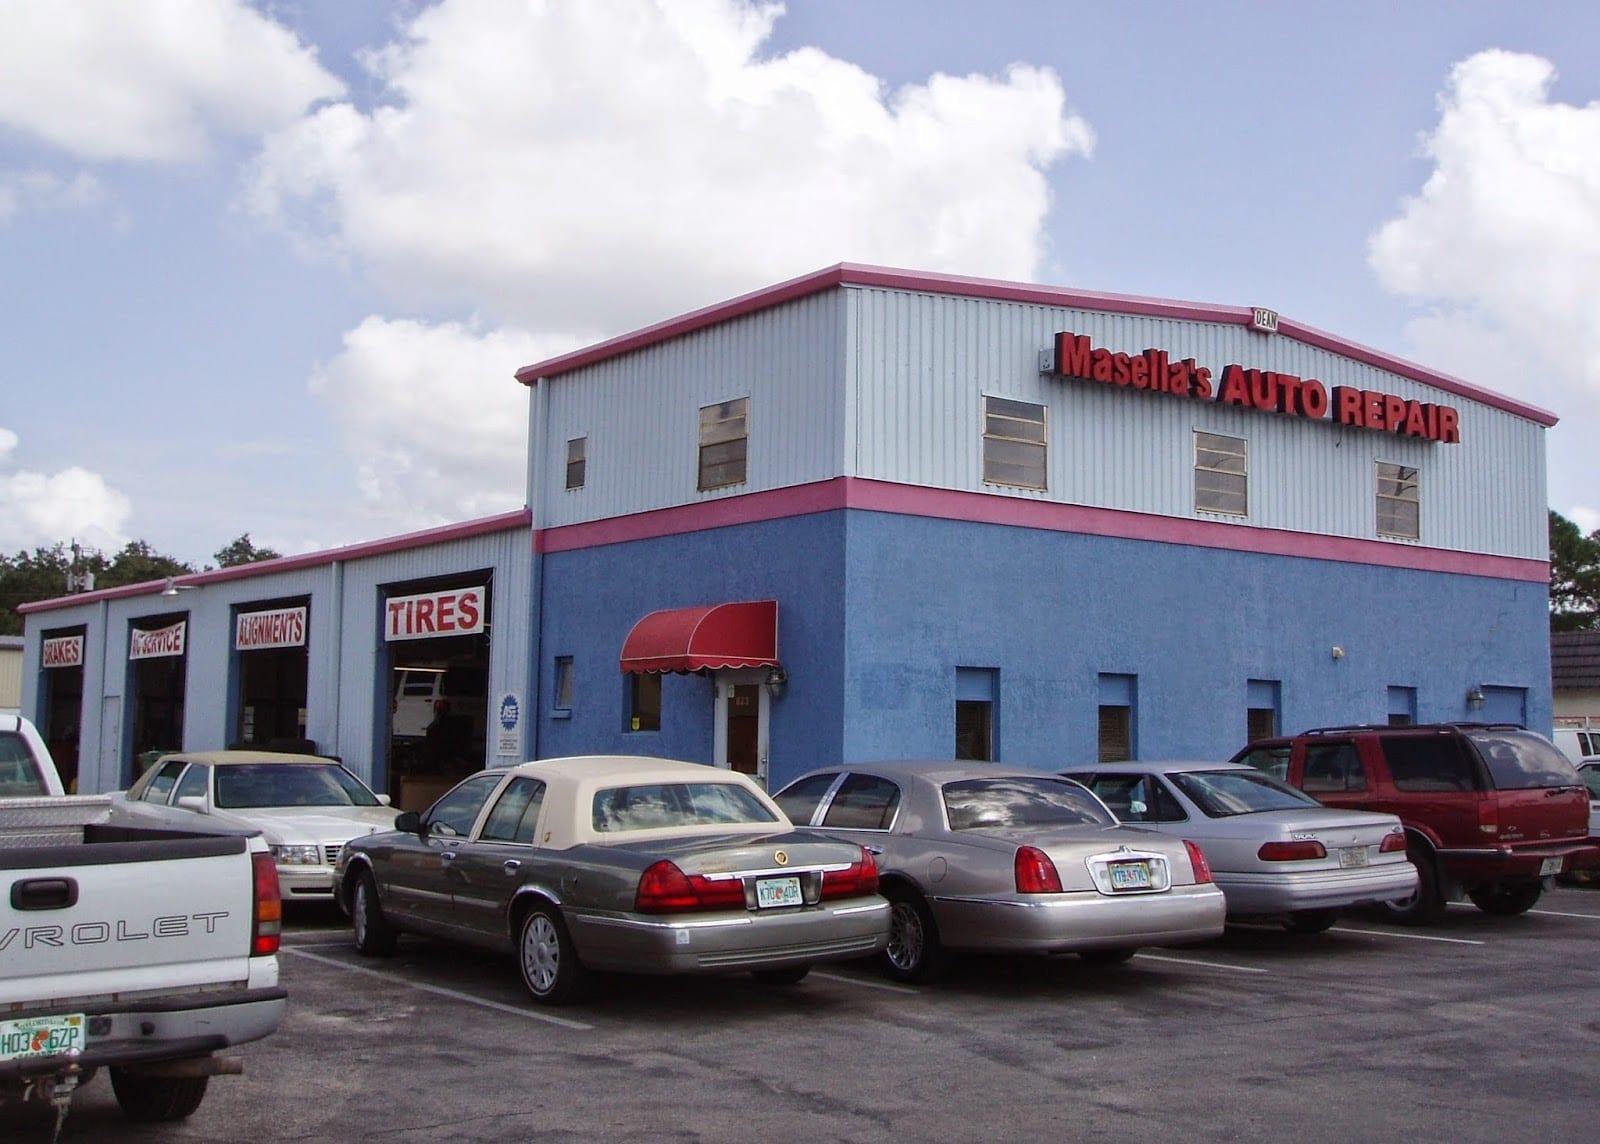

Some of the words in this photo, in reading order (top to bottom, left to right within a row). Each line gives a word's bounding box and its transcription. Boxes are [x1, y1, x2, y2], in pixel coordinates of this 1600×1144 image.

[1256, 310, 1277, 329] DEAN
[1055, 332, 1212, 399] Masella's
[1217, 364, 1327, 420] AUTO
[1332, 385, 1460, 444] REPAIR
[238, 611, 303, 646] ALIGNMENTS
[388, 593, 479, 635] TIRES
[44, 638, 80, 665] BRAKES
[49, 1027, 79, 1049] 6ZP
